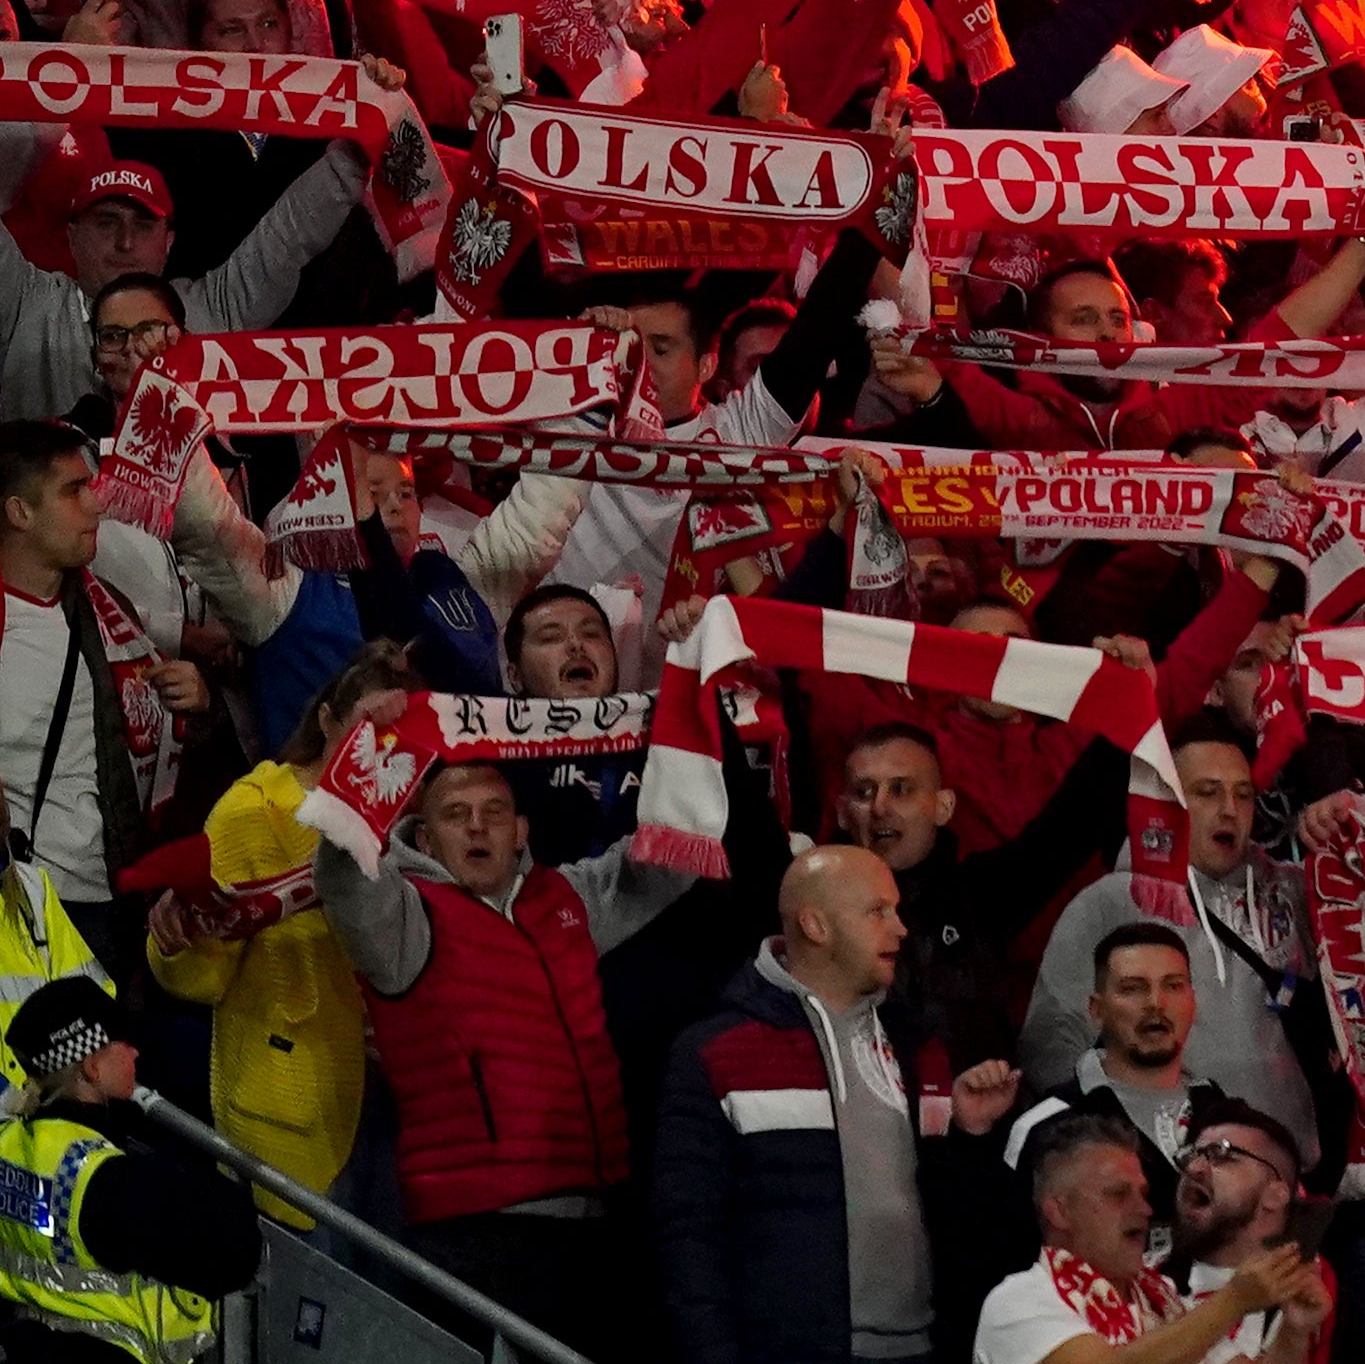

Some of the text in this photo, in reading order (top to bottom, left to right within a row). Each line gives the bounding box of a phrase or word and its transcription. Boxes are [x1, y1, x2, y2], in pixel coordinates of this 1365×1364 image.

[0, 49, 361, 129] OLSKA
[90, 169, 153, 196] POLSKA
[500, 113, 850, 210] OLSKA
[913, 135, 1338, 231] POLSKA
[900, 515, 974, 530] TADIUM,
[1025, 514, 1132, 530] SEPTEMBER
[1136, 516, 1185, 531] 2022
[1014, 478, 1215, 516] POLAND
